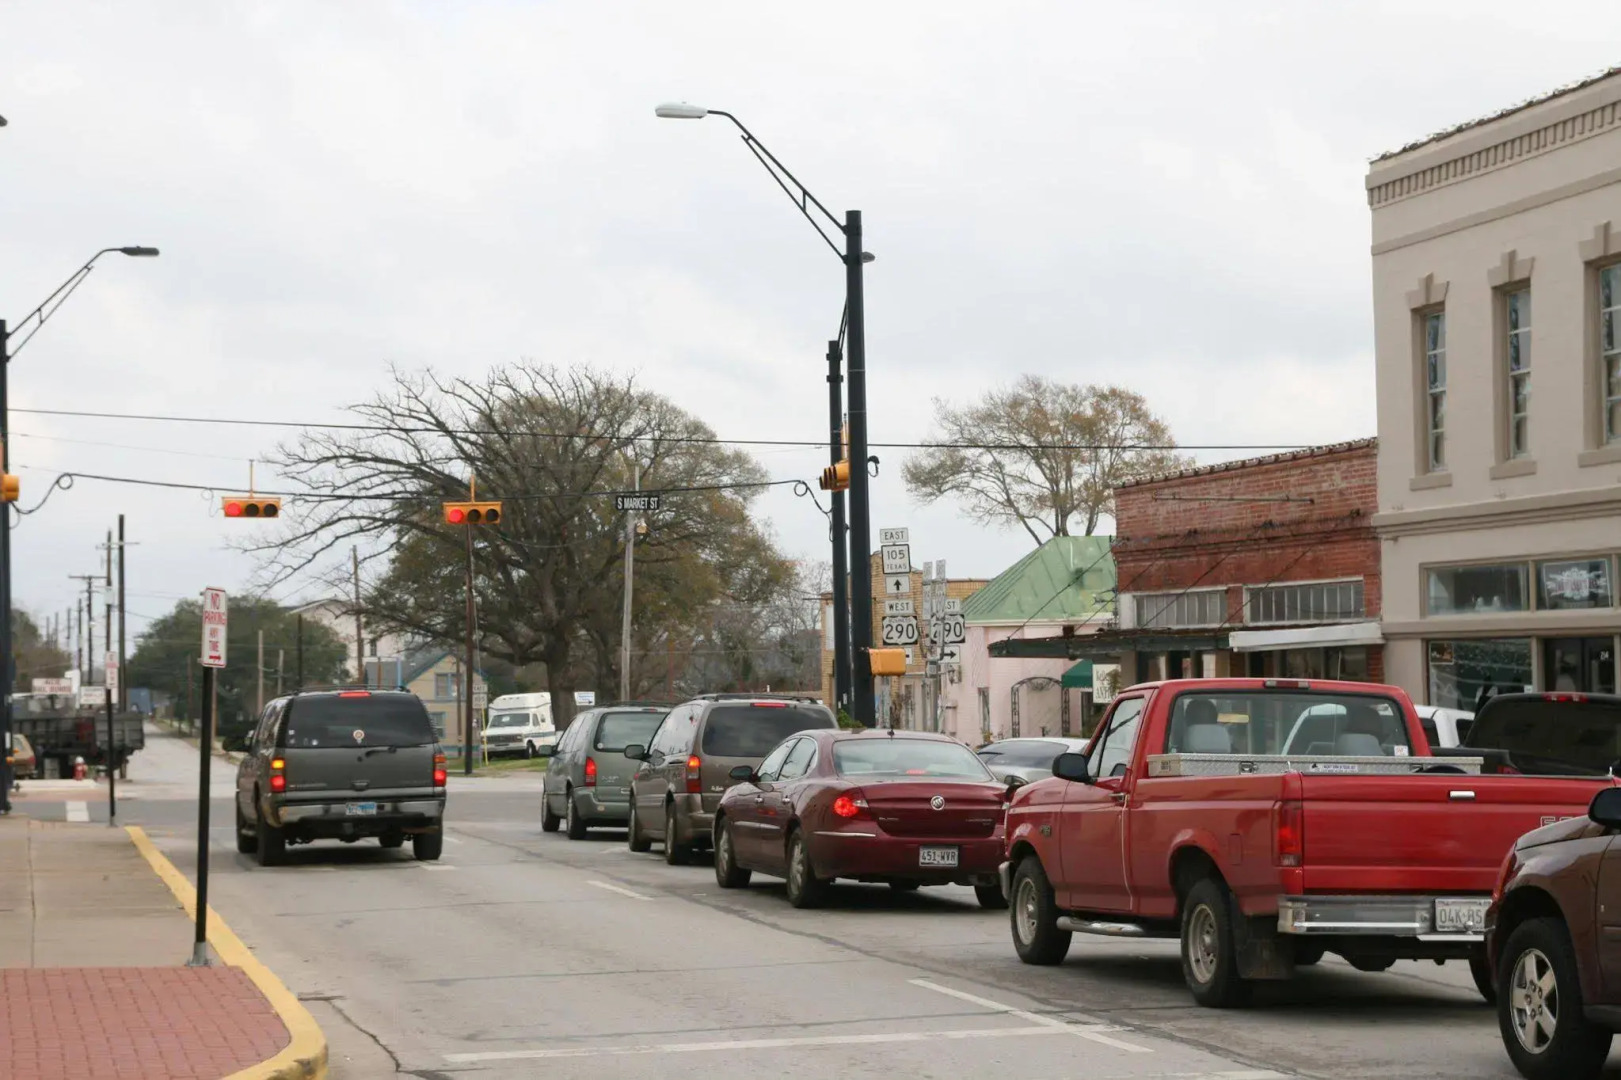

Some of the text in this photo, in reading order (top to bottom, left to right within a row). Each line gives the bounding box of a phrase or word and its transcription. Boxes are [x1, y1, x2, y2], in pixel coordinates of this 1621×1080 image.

[617, 497, 659, 509] S MARKET ST
[884, 531, 905, 540] EAST
[887, 550, 905, 560] 105
[211, 593, 220, 610] NO
[888, 602, 909, 611] WEST
[203, 610, 226, 625] PARKING
[885, 624, 915, 640] 290
[932, 622, 963, 639] 290
[209, 641, 219, 652] TIME
